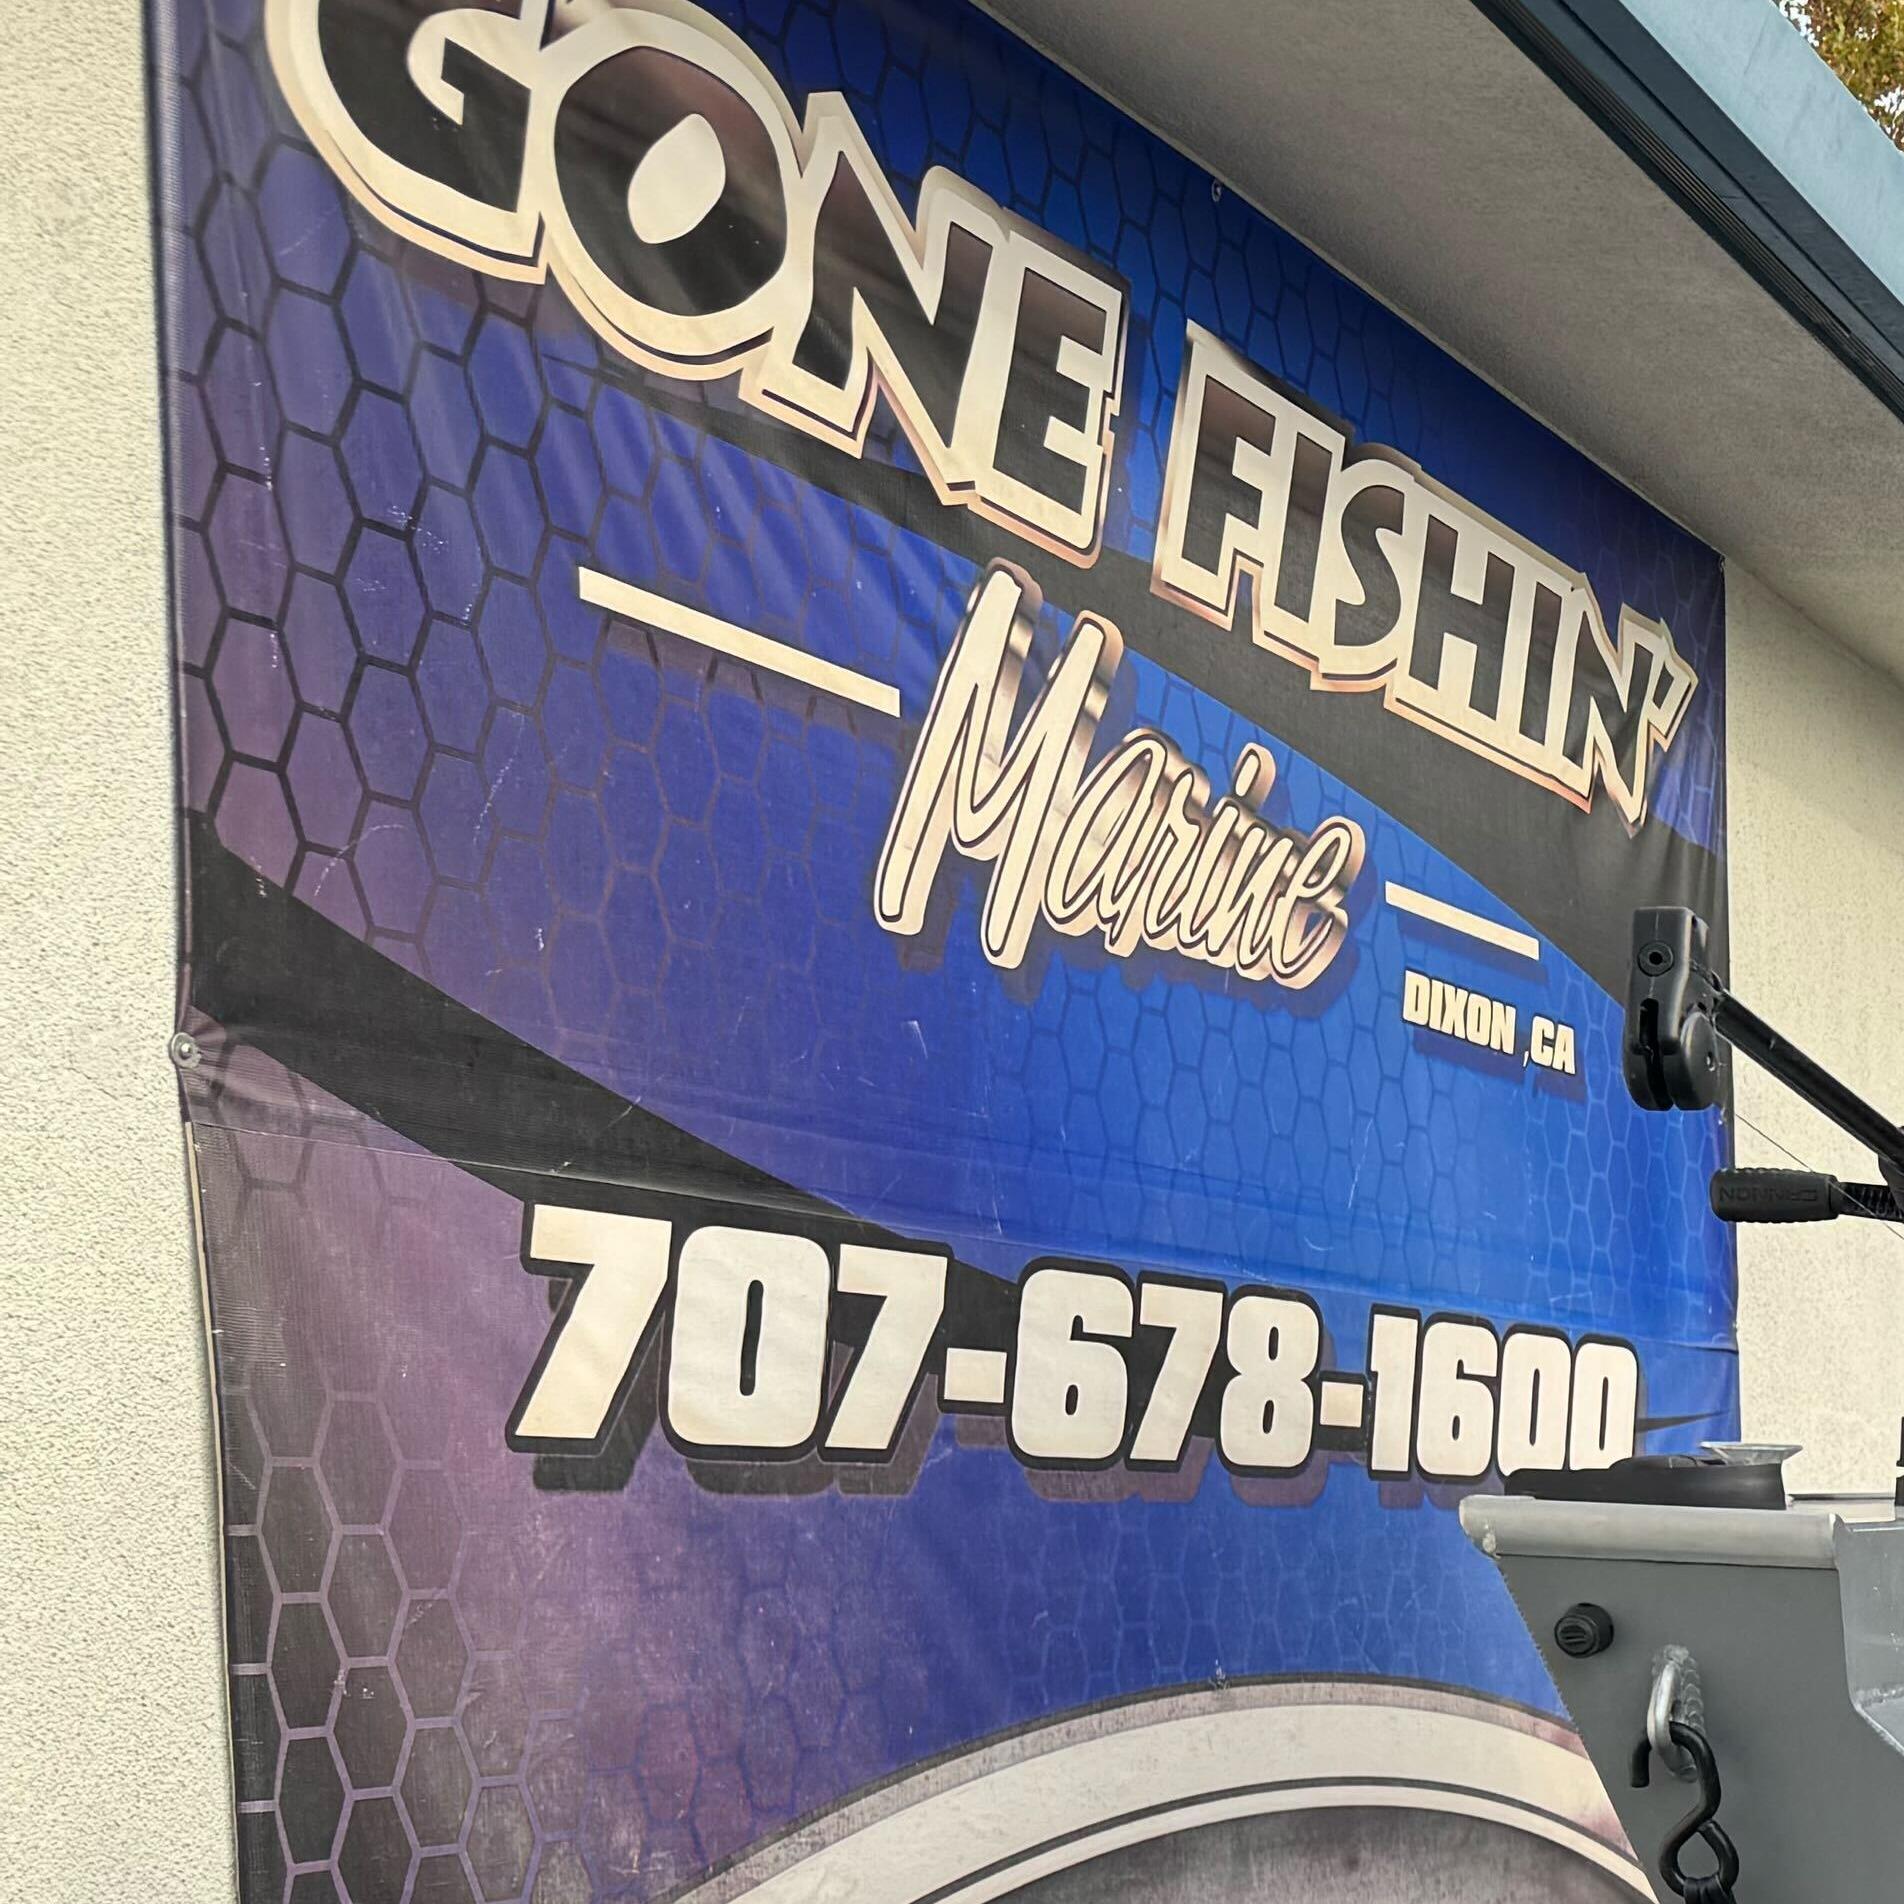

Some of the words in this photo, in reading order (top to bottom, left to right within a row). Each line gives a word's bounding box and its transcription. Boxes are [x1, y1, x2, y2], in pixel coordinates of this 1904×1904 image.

[268, 0, 1128, 566] GONE
[876, 560, 1362, 988] Marine
[1402, 969, 1517, 1055] DIXON
[510, 1203, 1640, 1474] 707-678-1600
